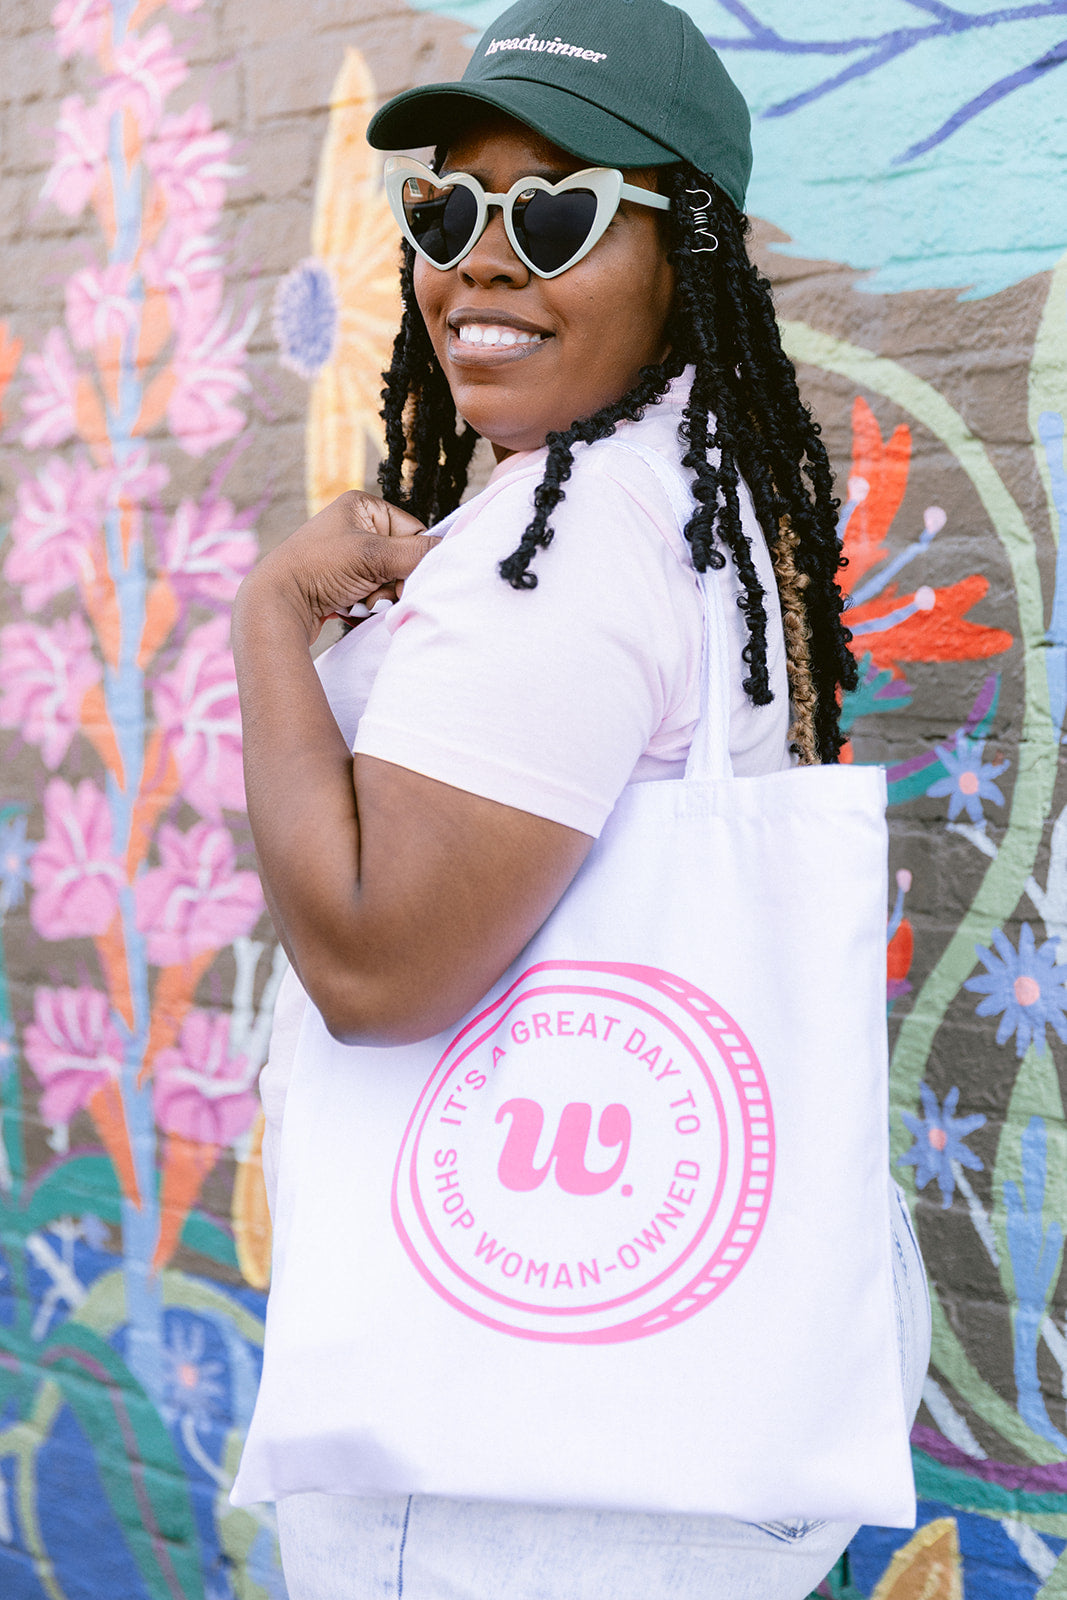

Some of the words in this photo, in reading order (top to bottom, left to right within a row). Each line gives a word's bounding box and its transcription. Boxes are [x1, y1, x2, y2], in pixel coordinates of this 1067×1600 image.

[484, 33, 607, 63] breadwinner
[439, 1069, 488, 1127] IT'S
[491, 1045, 507, 1069] A
[510, 1010, 622, 1046] GREAT
[623, 1027, 682, 1082] DAY
[669, 1088, 701, 1136] TO
[433, 1148, 476, 1231] SHOP
[474, 1159, 701, 1290] WOMAN-OWNED
